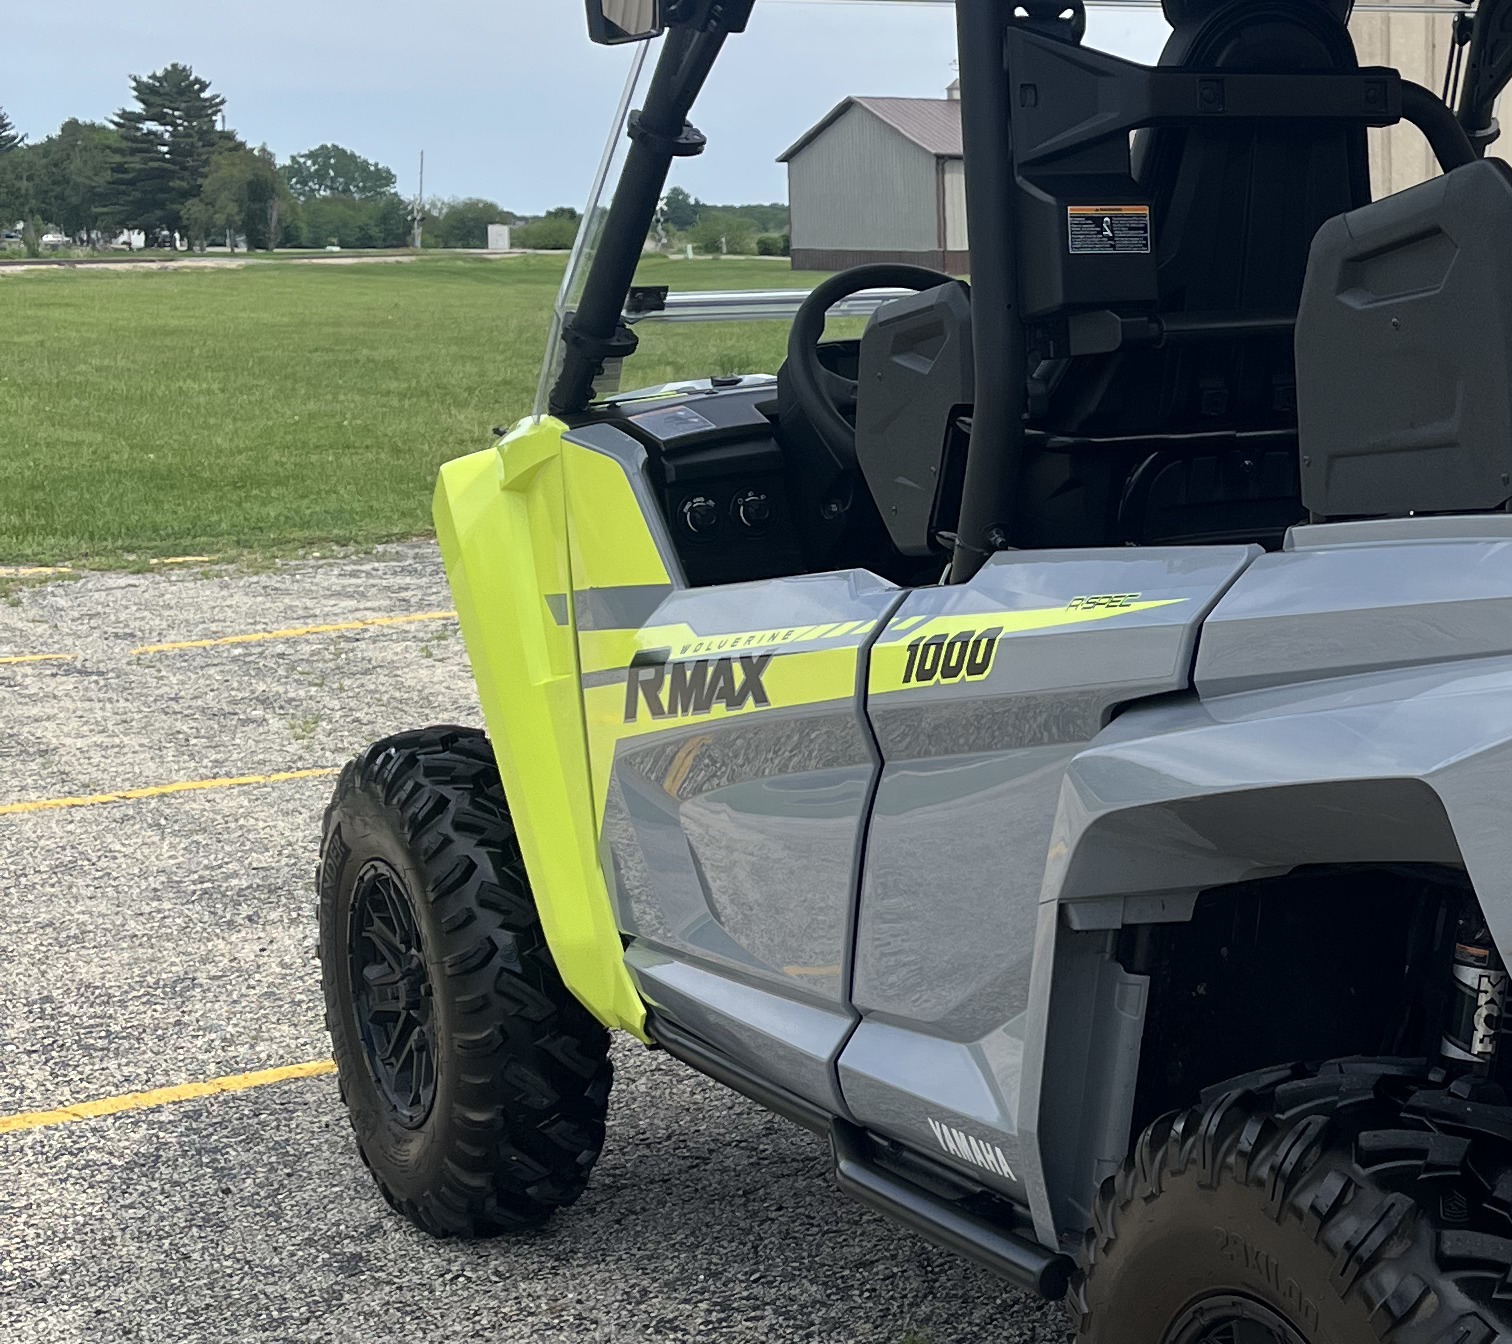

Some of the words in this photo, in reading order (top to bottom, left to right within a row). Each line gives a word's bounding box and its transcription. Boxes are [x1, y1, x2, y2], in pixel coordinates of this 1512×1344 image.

[679, 629, 795, 655] WOLVERINE
[902, 625, 1004, 684] 1000
[623, 646, 779, 724] RMAX
[1470, 975, 1506, 1056] FOX
[928, 1117, 1017, 1182] YAMAHA
